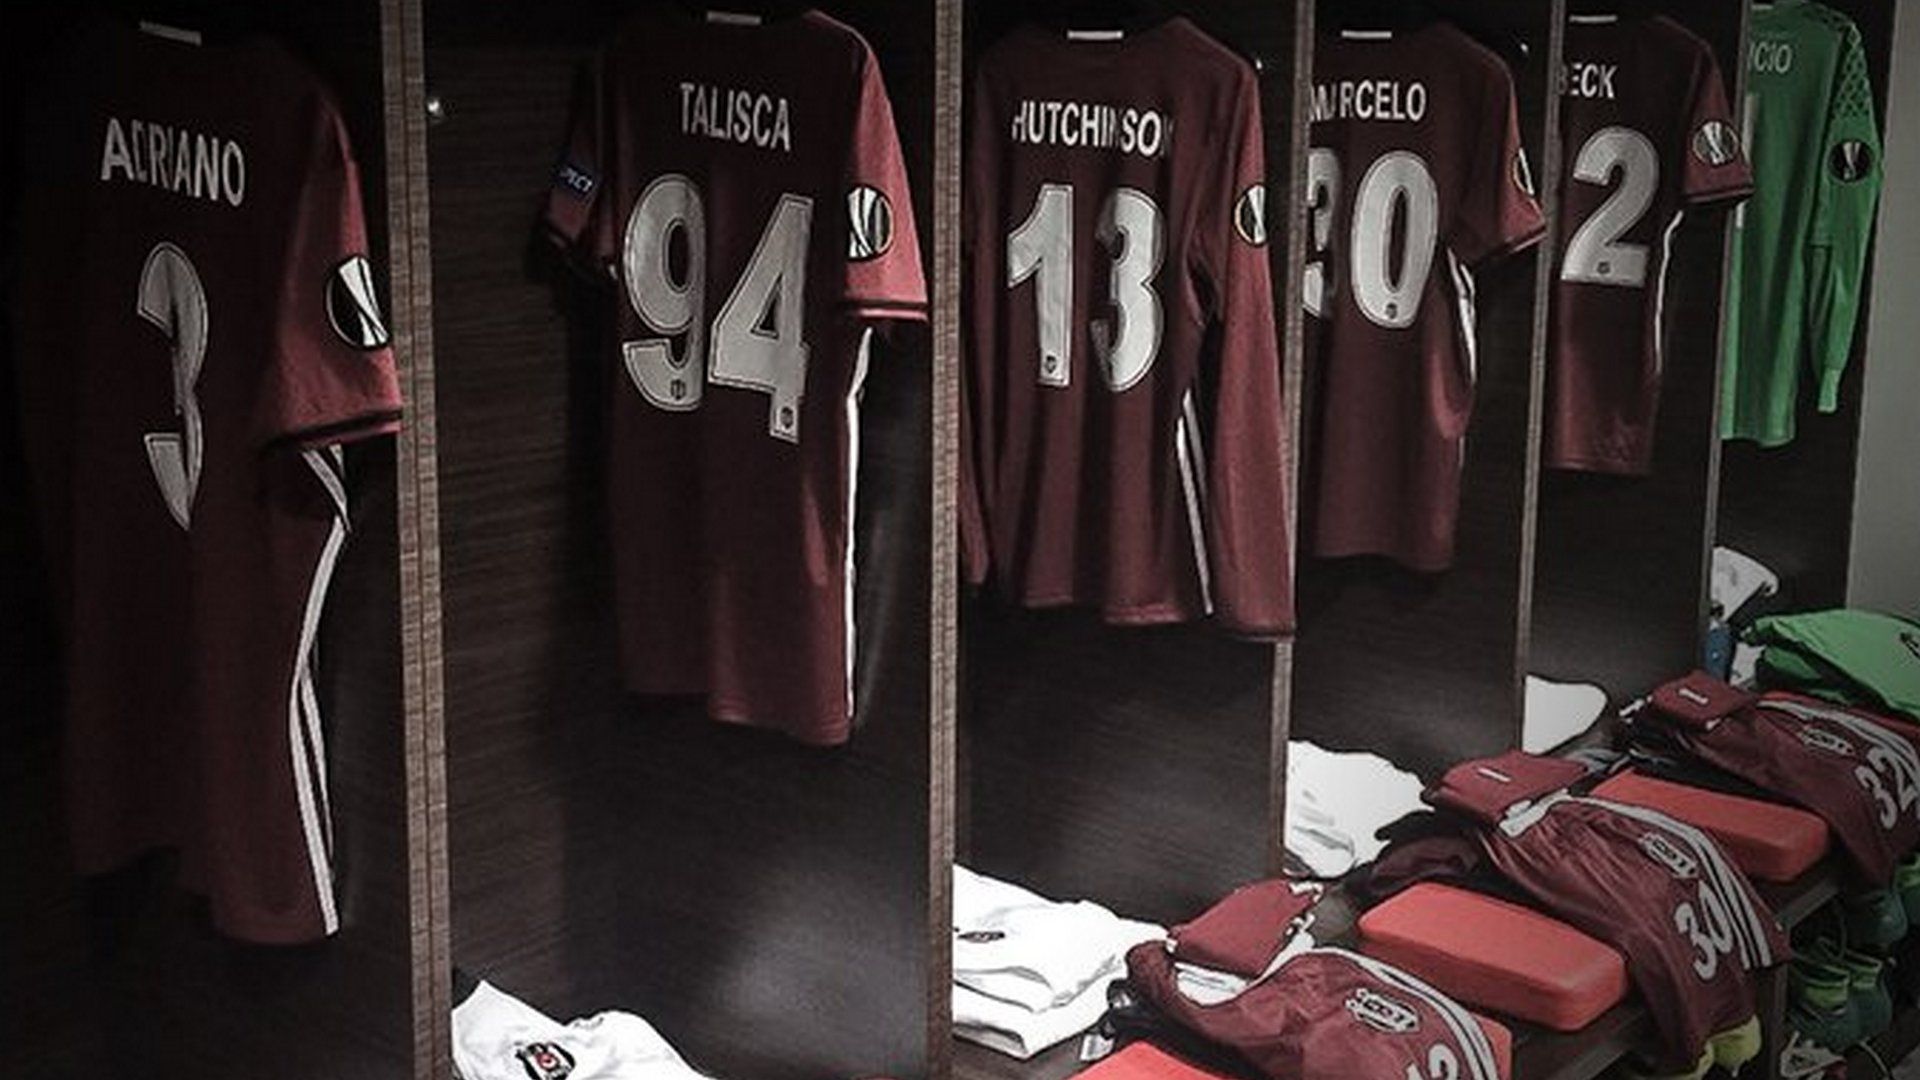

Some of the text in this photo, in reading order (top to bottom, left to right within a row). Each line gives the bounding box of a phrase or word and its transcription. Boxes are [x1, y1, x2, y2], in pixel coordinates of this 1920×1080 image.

[680, 82, 791, 152] TALISCA
[1012, 100, 1173, 156] HUTCHINSO
[1008, 183, 1165, 392] 13
[1561, 126, 1660, 288] 2
[137, 242, 208, 530] 3
[622, 173, 814, 444] 94
[1674, 878, 1734, 980] 30
